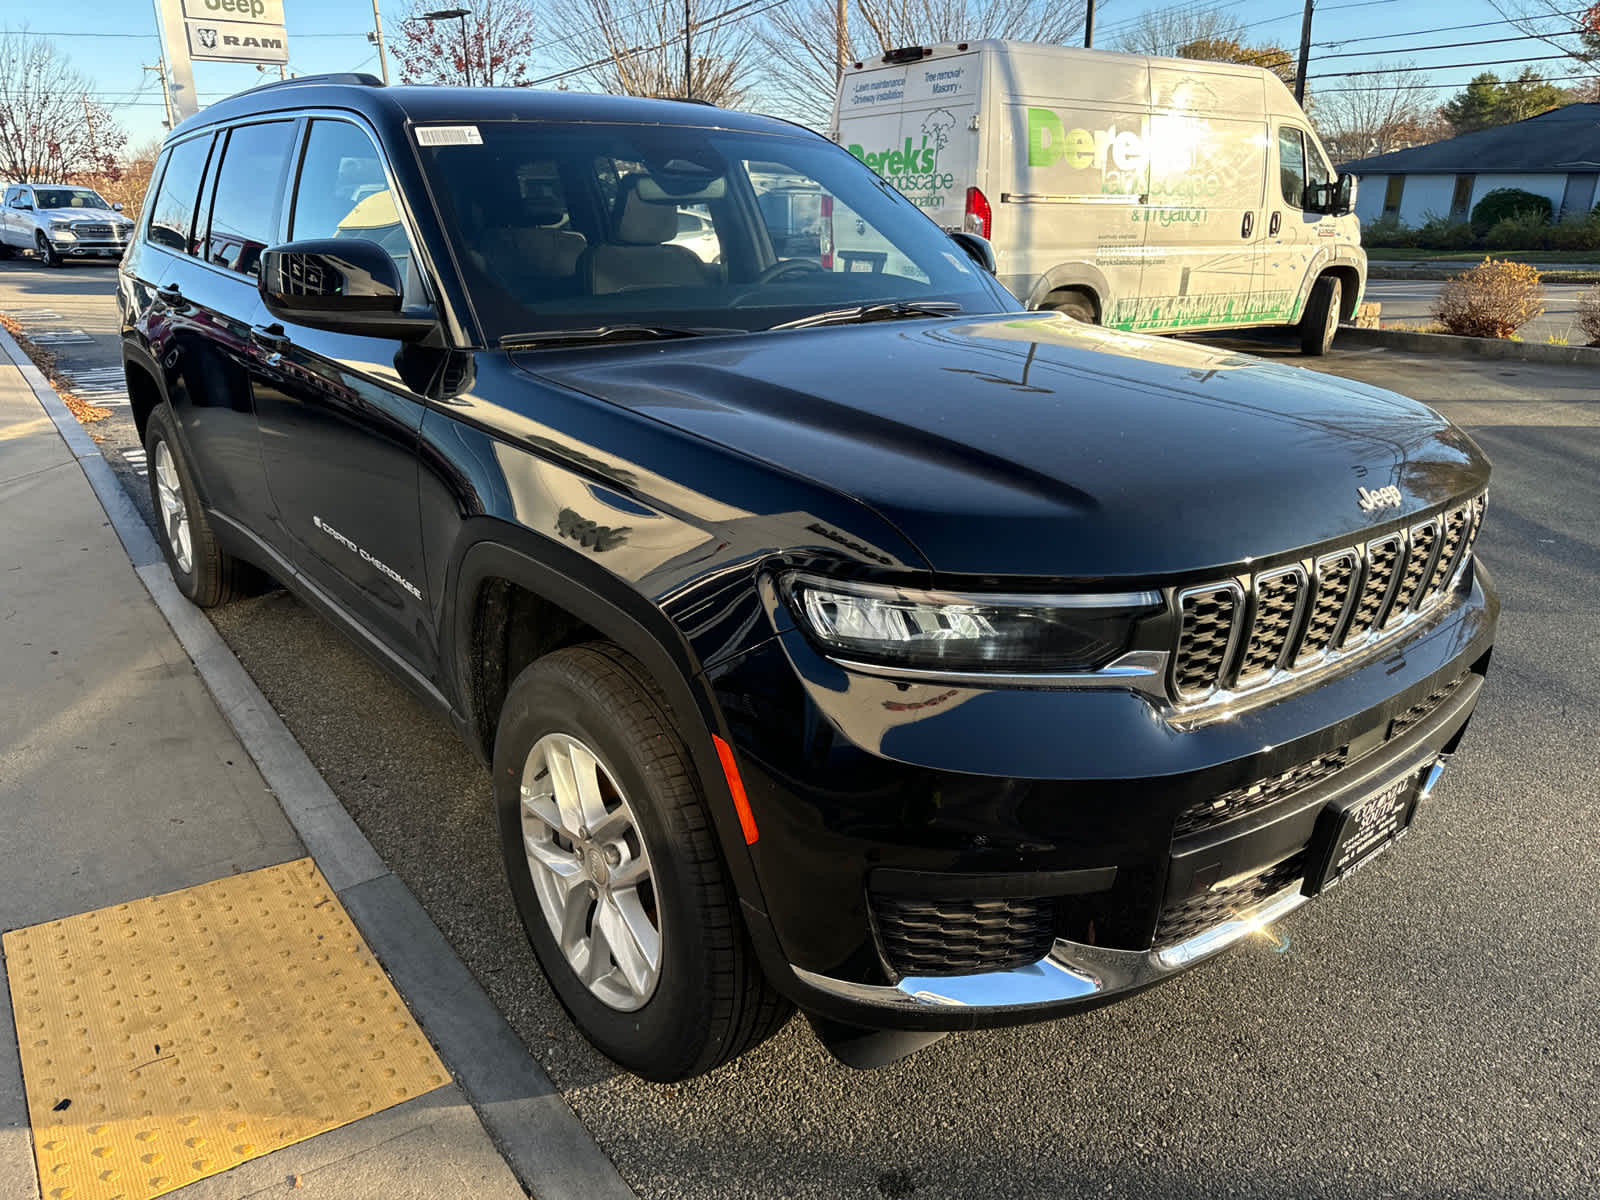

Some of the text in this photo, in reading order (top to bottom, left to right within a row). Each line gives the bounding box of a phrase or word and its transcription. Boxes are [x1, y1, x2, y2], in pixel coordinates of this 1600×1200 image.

[223, 35, 282, 48] RAM
[932, 84, 958, 94] Masonry
[884, 172, 953, 195] ndscape
[1131, 209, 1140, 222] &
[1358, 486, 1402, 510] Jeep
